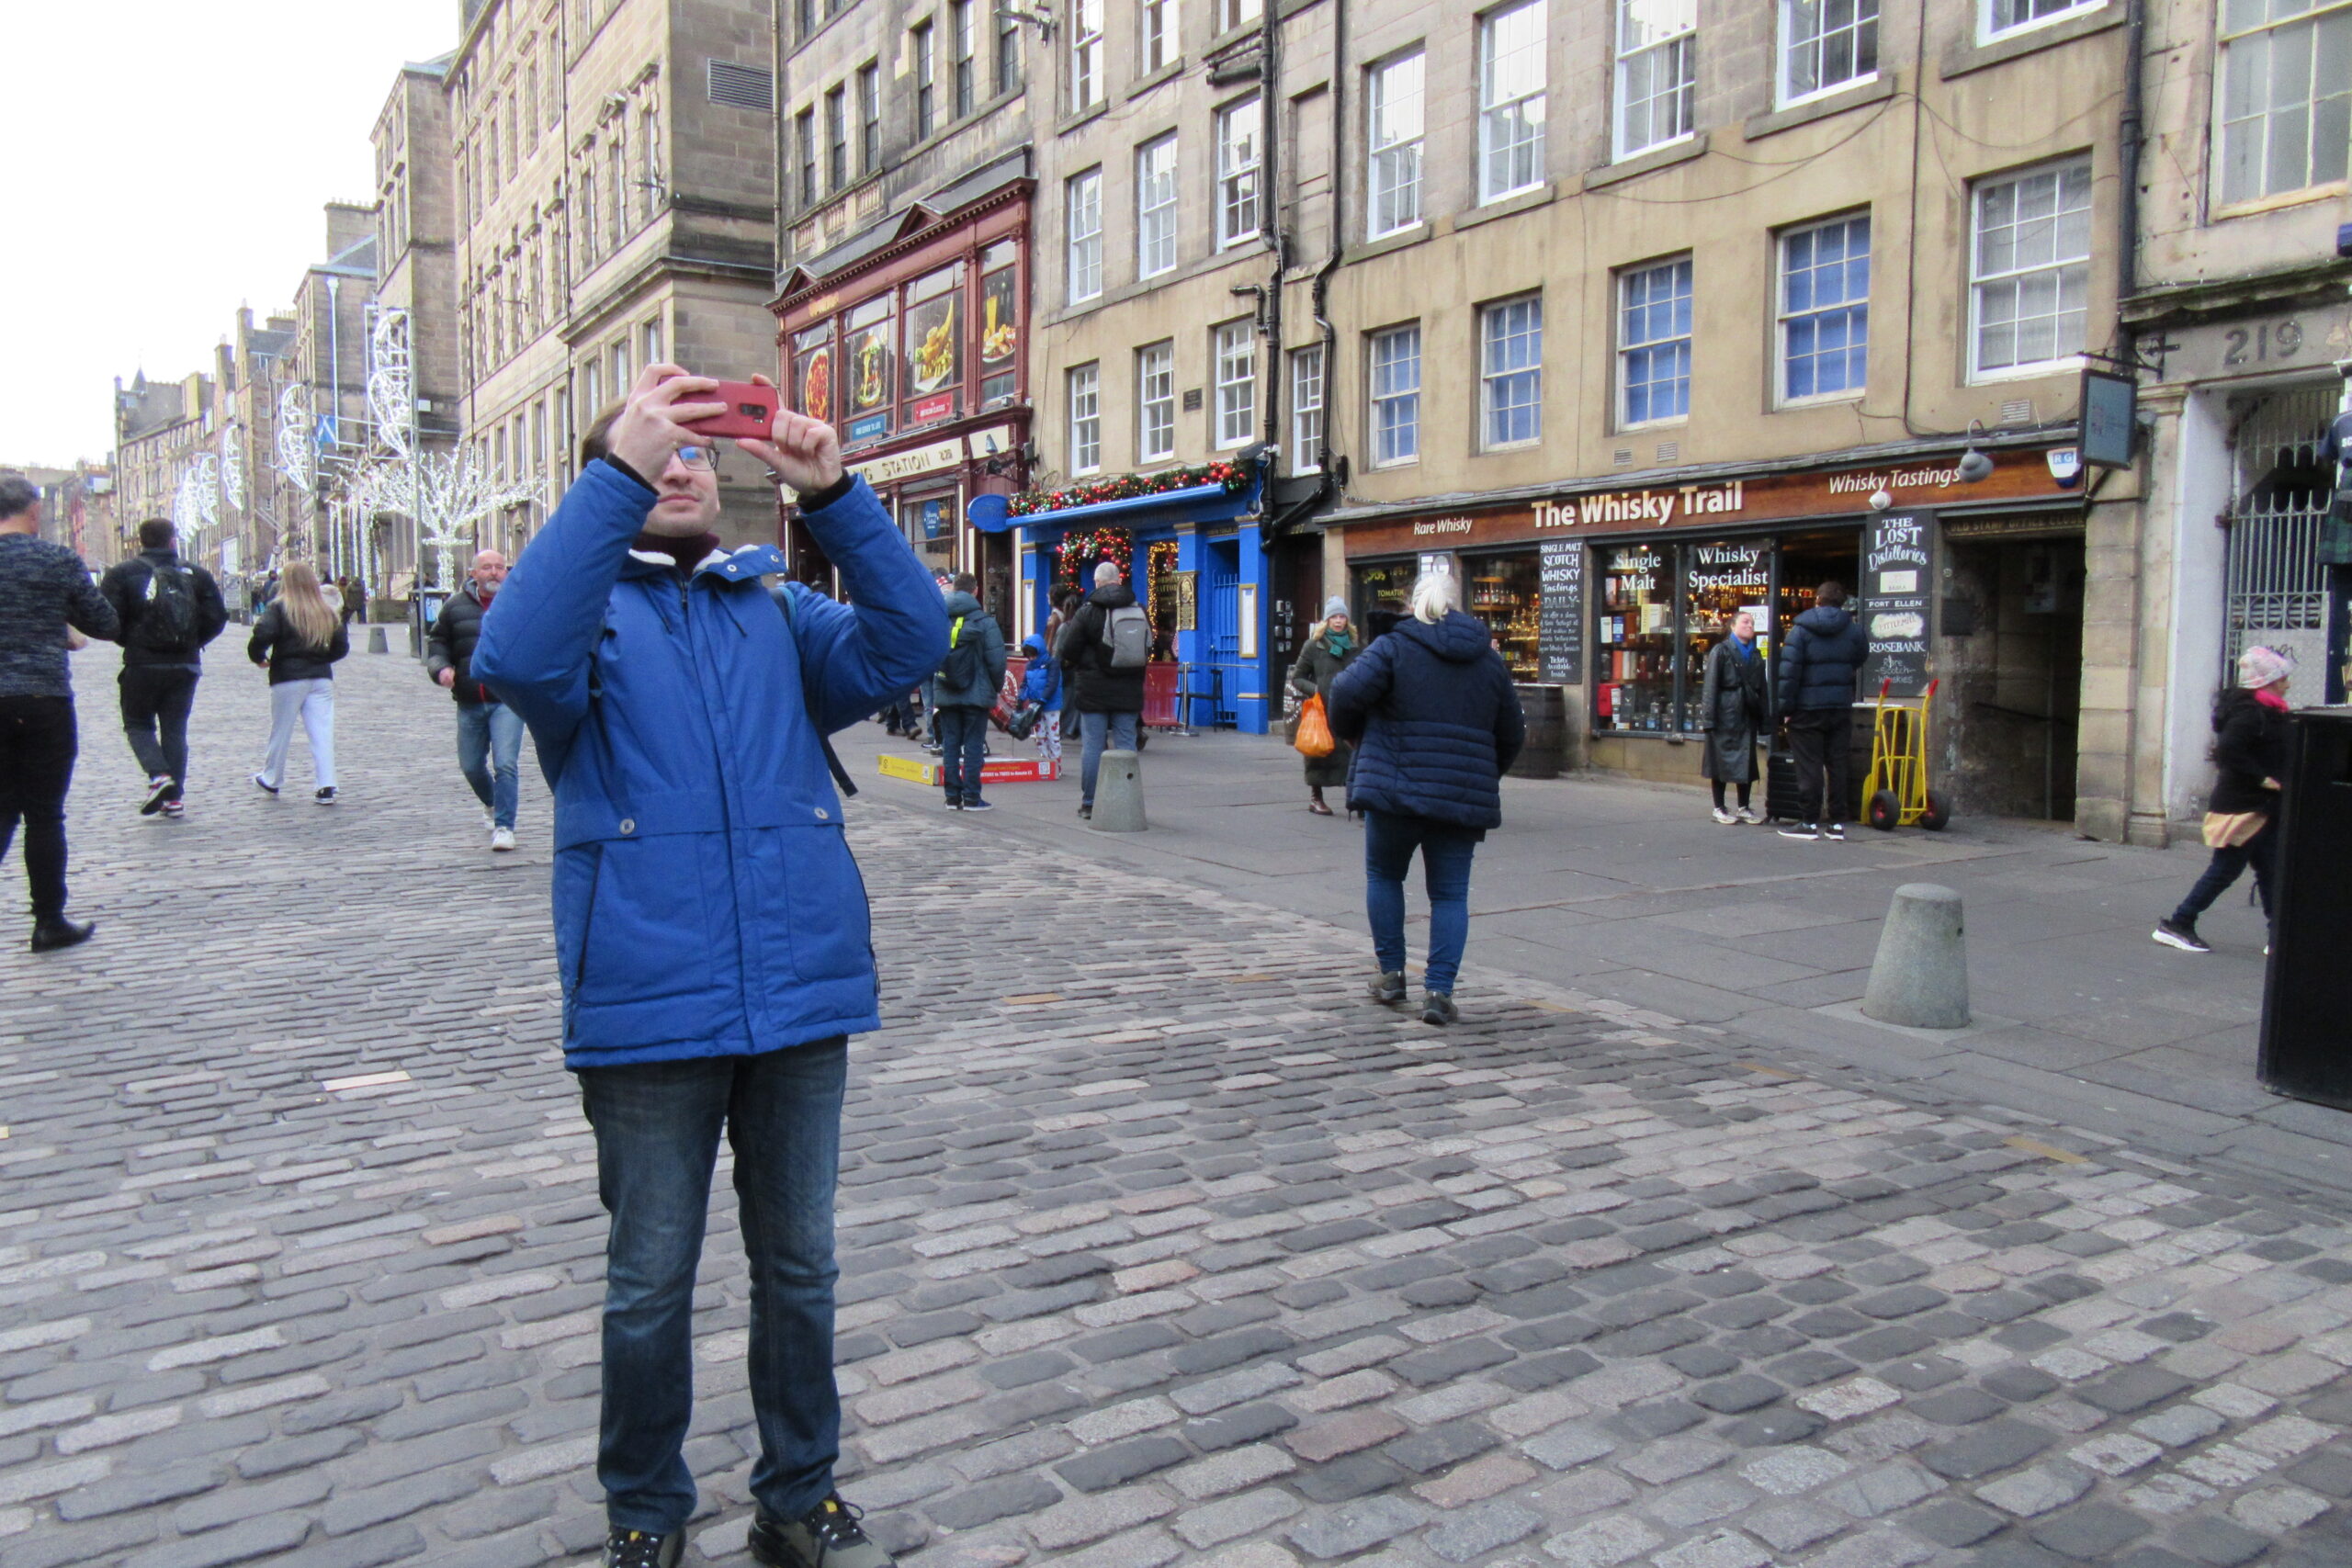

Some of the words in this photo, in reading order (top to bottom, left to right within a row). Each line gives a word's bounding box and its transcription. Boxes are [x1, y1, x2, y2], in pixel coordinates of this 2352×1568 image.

[2223, 321, 2302, 366] 219
[882, 452, 931, 477] STATION
[1829, 472, 1888, 494] Whisky
[1890, 467, 1961, 488] Tastings
[1532, 501, 1575, 528] The
[1579, 491, 1674, 525] Whisky
[1679, 480, 1744, 515] Trail
[1414, 521, 1436, 536] Rare
[1436, 518, 1473, 535] Whisky
[1882, 517, 1913, 529] THE
[1874, 526, 1922, 550] LOST
[1540, 544, 1564, 554] SINGLE
[1565, 542, 1582, 552] MALT
[1698, 545, 1760, 567] Whisky
[1544, 554, 1579, 569] SCOTCH
[1615, 553, 1661, 573] Single
[1869, 545, 1928, 571] Distilleries
[1542, 569, 1580, 581] WHISKY
[1621, 574, 1656, 591] Malt
[1689, 568, 1769, 593] Specialist
[1377, 589, 1404, 598] TOMATIN
[1543, 582, 1577, 594] Tastings
[1869, 600, 1890, 608] PORT
[1894, 599, 1922, 607] ELLEN
[1869, 641, 1926, 653] ROSEBANK
